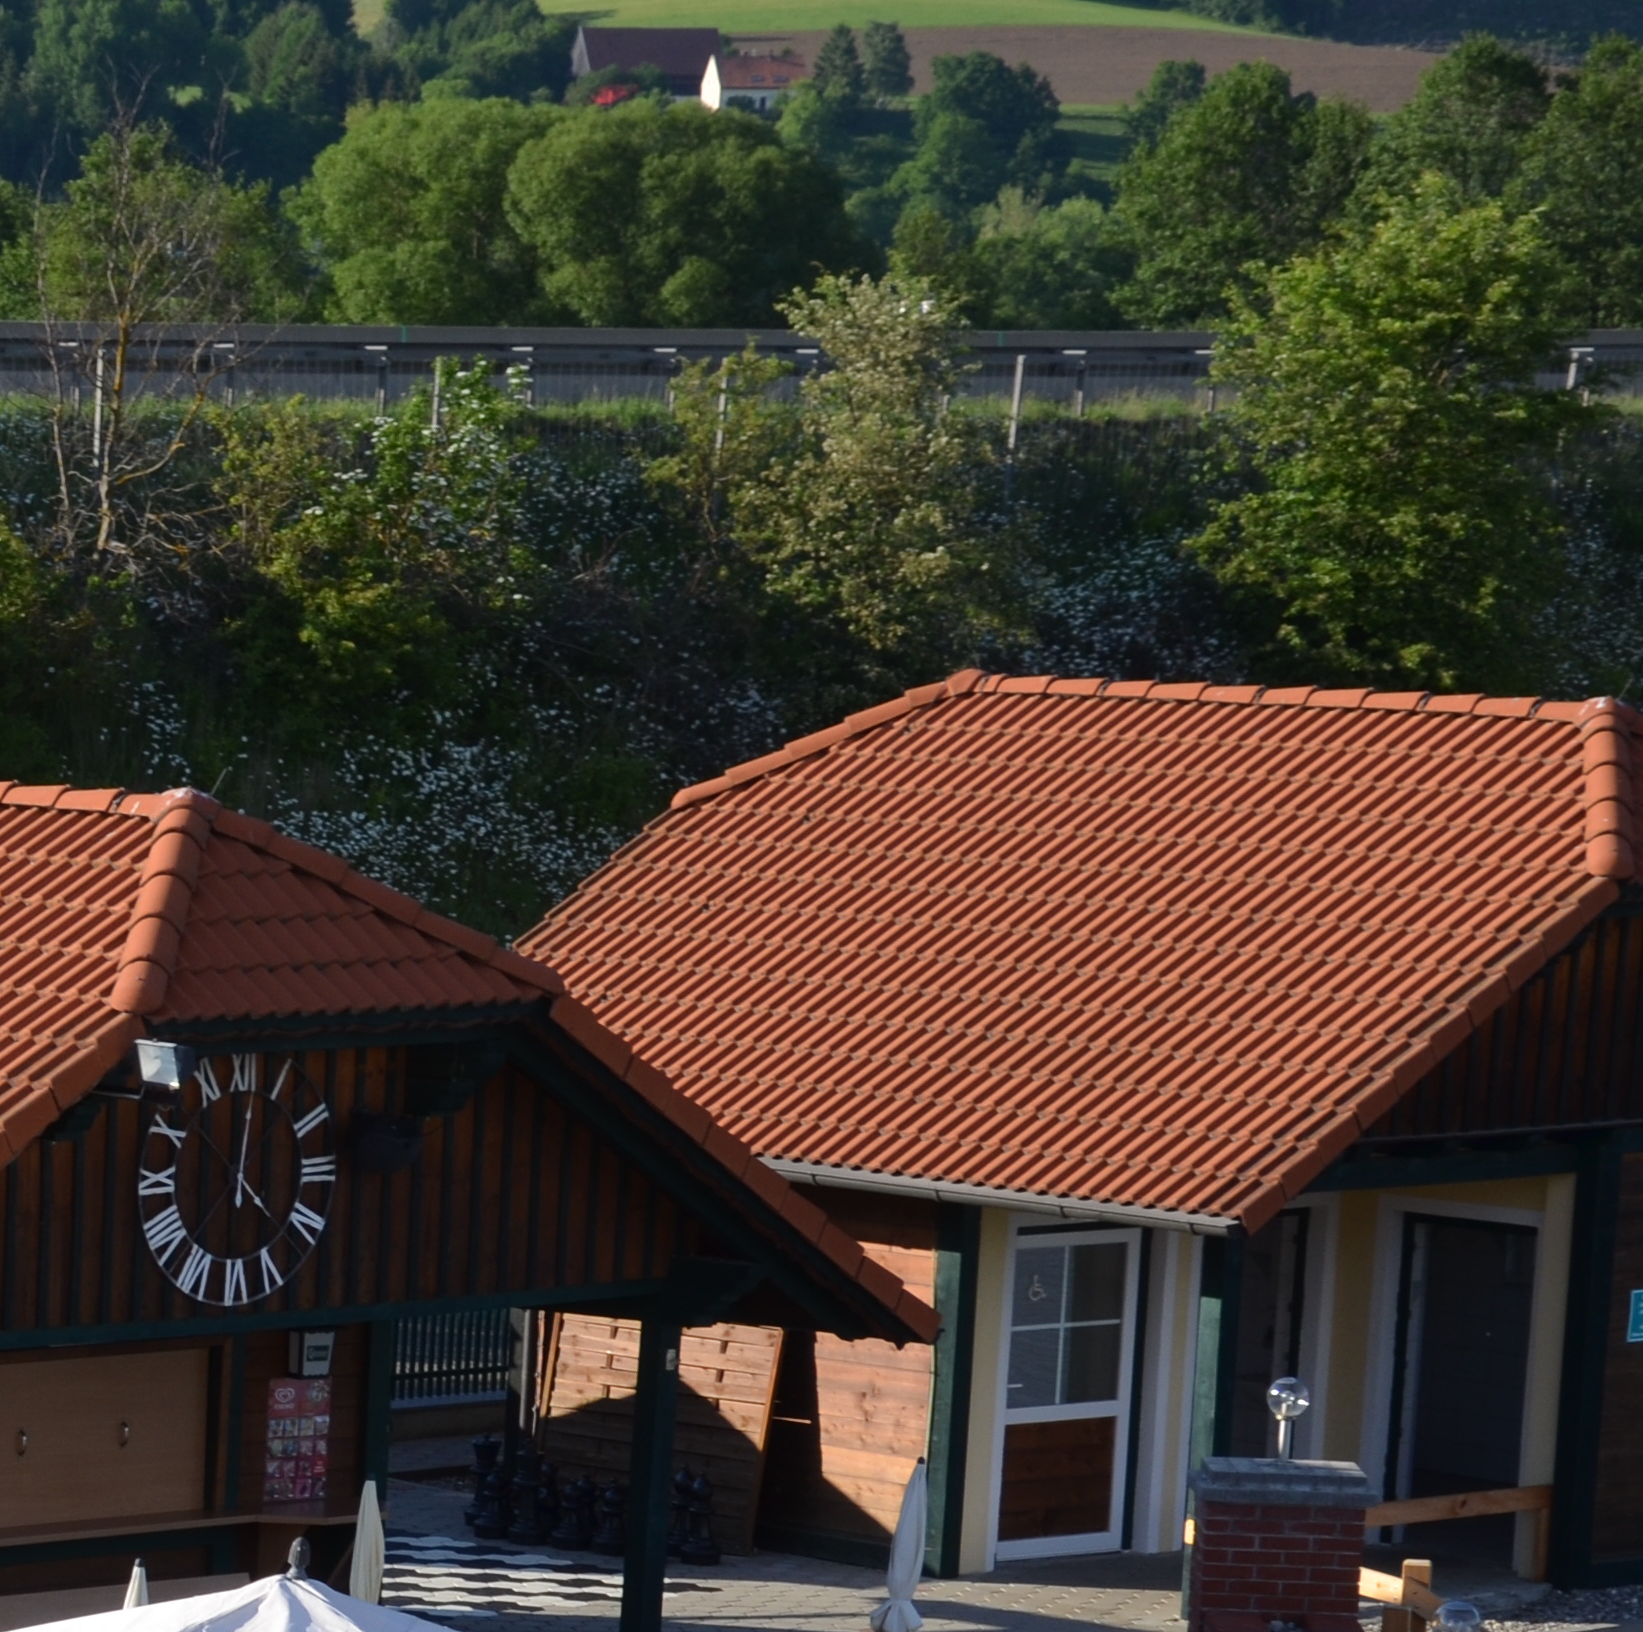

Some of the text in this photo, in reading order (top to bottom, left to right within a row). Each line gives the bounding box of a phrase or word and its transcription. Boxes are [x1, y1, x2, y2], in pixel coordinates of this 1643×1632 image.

[193, 1057, 222, 1108] XI
[230, 1053, 256, 1092] XII
[270, 1058, 293, 1100] I
[148, 1114, 187, 1149] X
[293, 1102, 330, 1139] II
[138, 1166, 176, 1196] IX
[300, 1154, 336, 1183] III
[143, 1204, 188, 1267] VIII
[290, 1201, 326, 1246] IV
[176, 1243, 212, 1302] VII
[223, 1258, 248, 1307] VI
[260, 1247, 284, 1295] V
